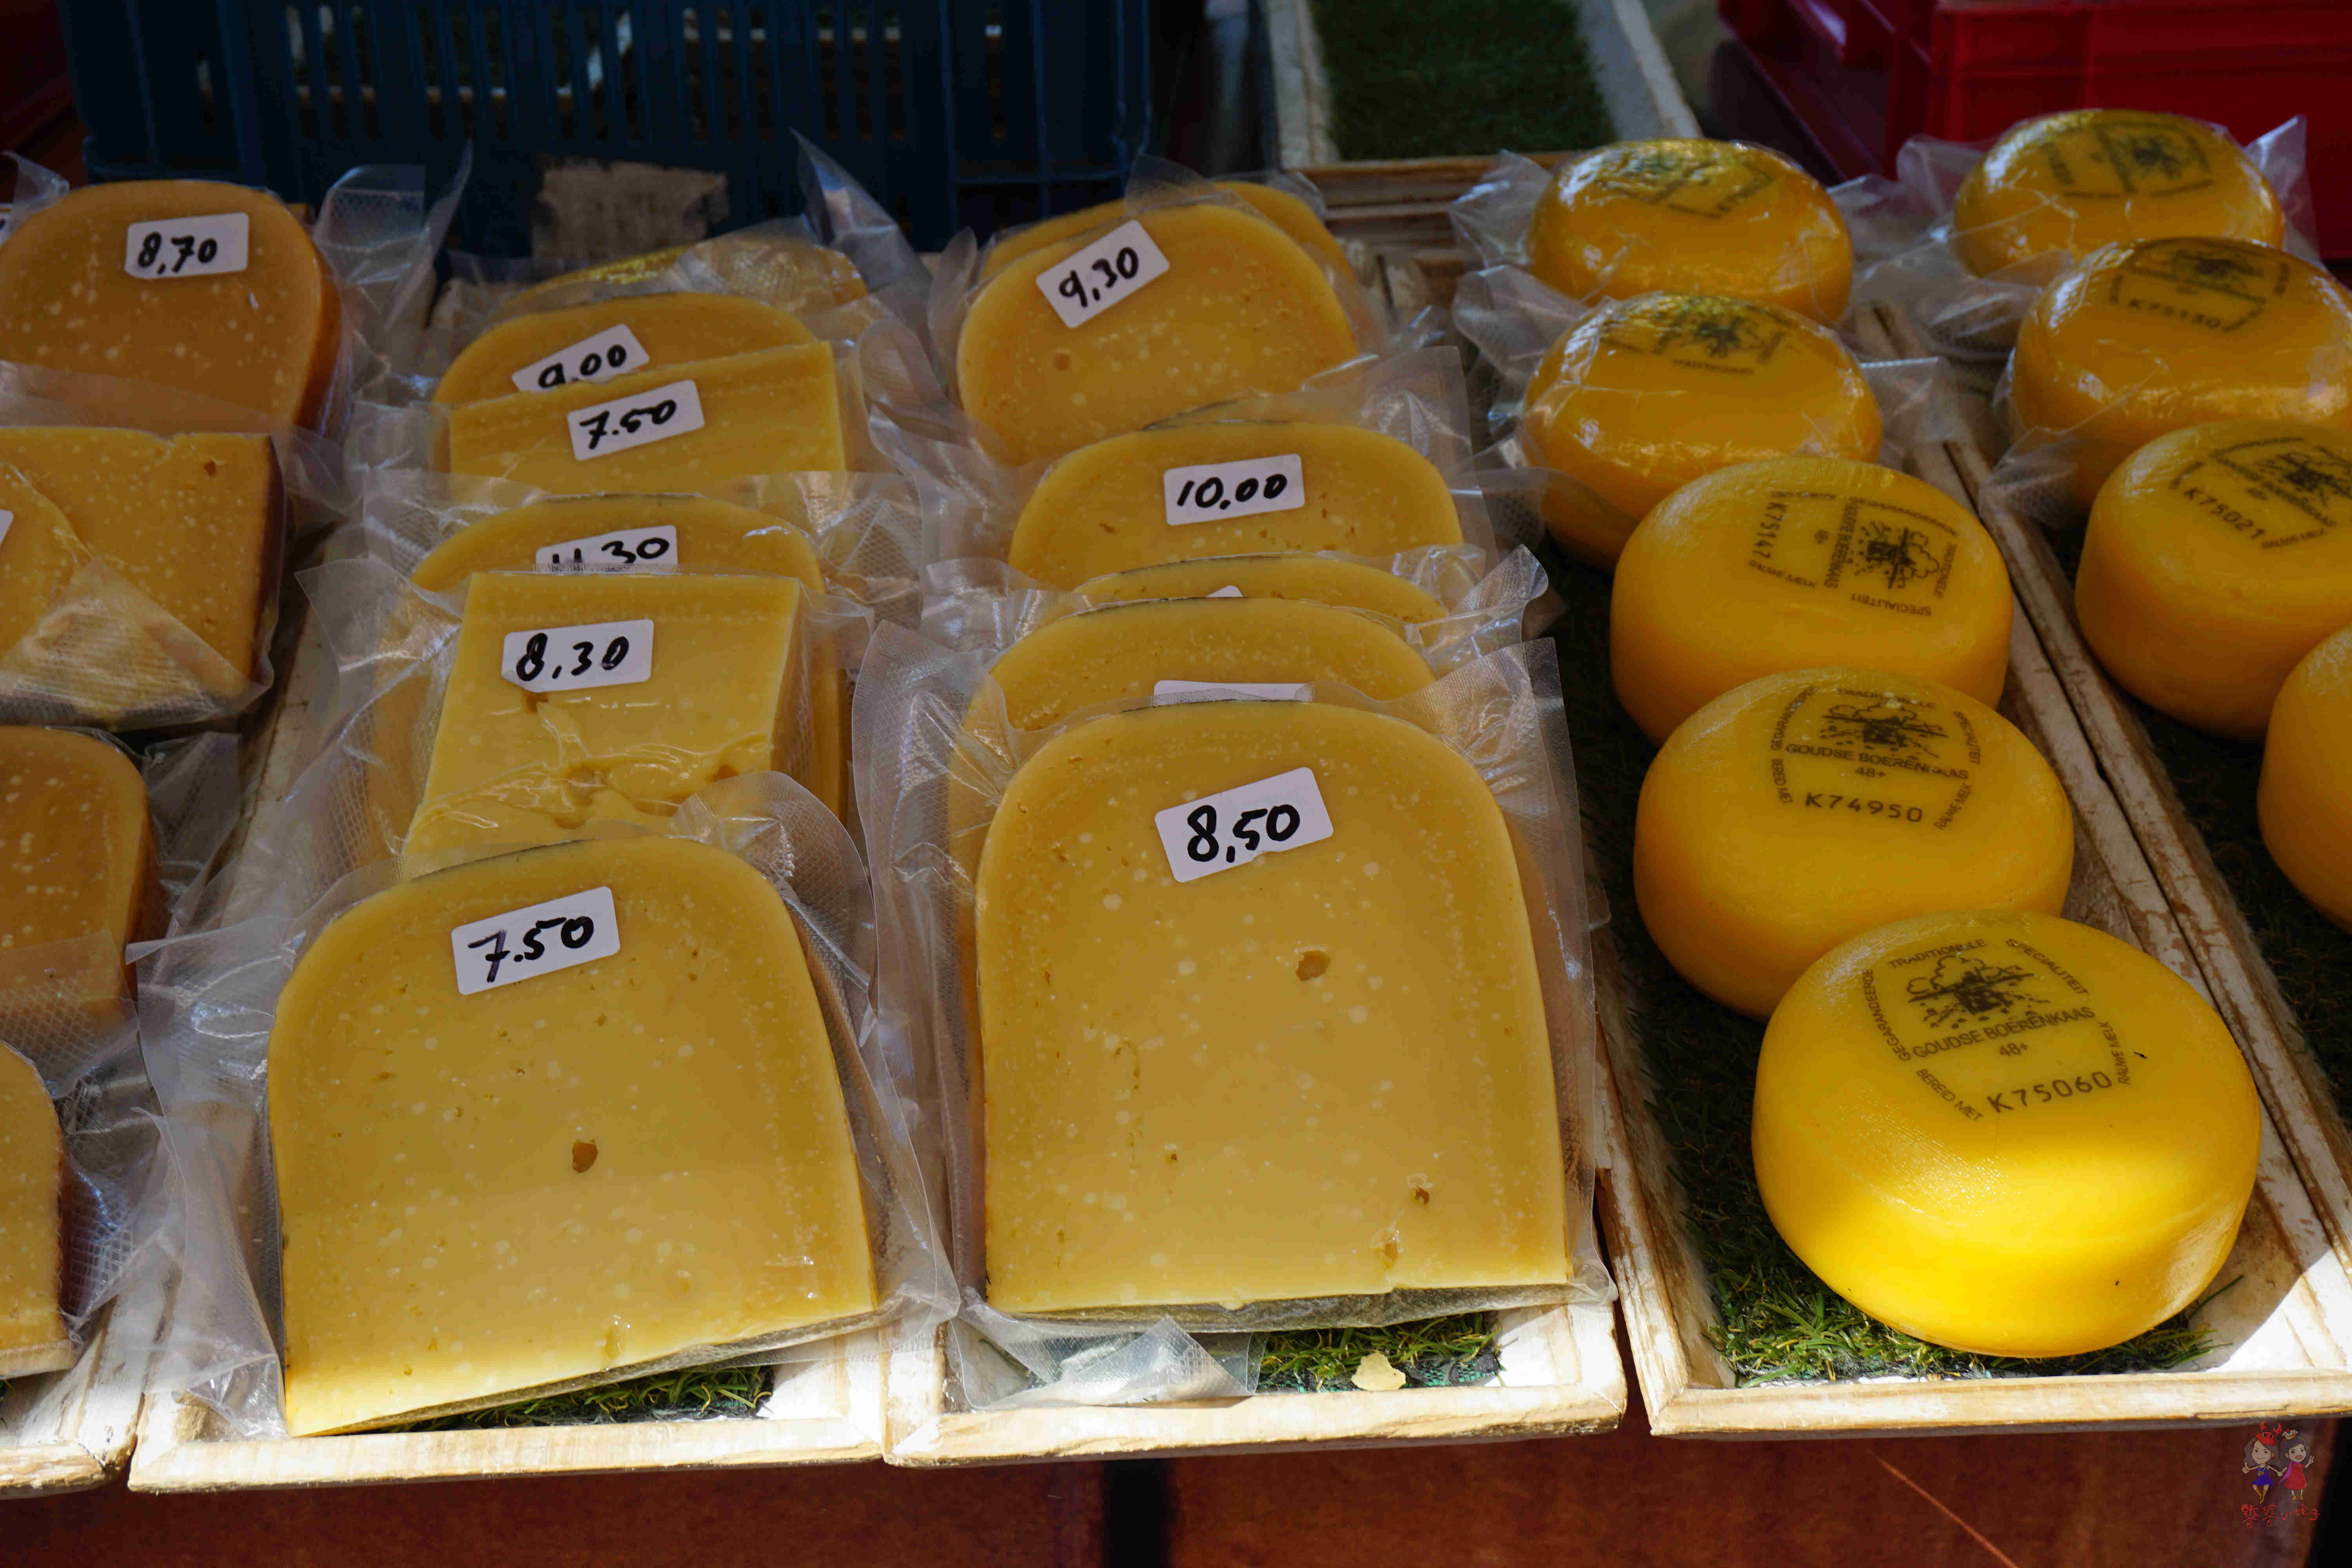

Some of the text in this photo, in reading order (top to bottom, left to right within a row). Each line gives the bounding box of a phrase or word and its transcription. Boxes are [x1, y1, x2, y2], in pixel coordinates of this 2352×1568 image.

[138, 231, 218, 274] 8,70
[1059, 246, 1139, 308] 9,30
[579, 399, 677, 449] 7.50
[516, 632, 629, 682] 8,30
[1785, 742, 1968, 780] GOUDSE BOERENKAAS
[1855, 766, 1886, 778] 48+
[1805, 791, 1923, 823] K74950
[1187, 804, 1300, 863] 8,50
[467, 916, 594, 983] 7.50
[2005, 938, 2089, 997] SPECIALITEIT
[1862, 969, 1911, 1061] GEGARANDEERDE
[1912, 1006, 2095, 1058] GOUDSE BOERENKAAS
[1999, 1042, 2028, 1057] 48+
[2098, 1020, 2130, 1085] RAUWE MELK
[1916, 1068, 1984, 1122] BEREID MET
[1986, 1071, 2113, 1114] K75060
